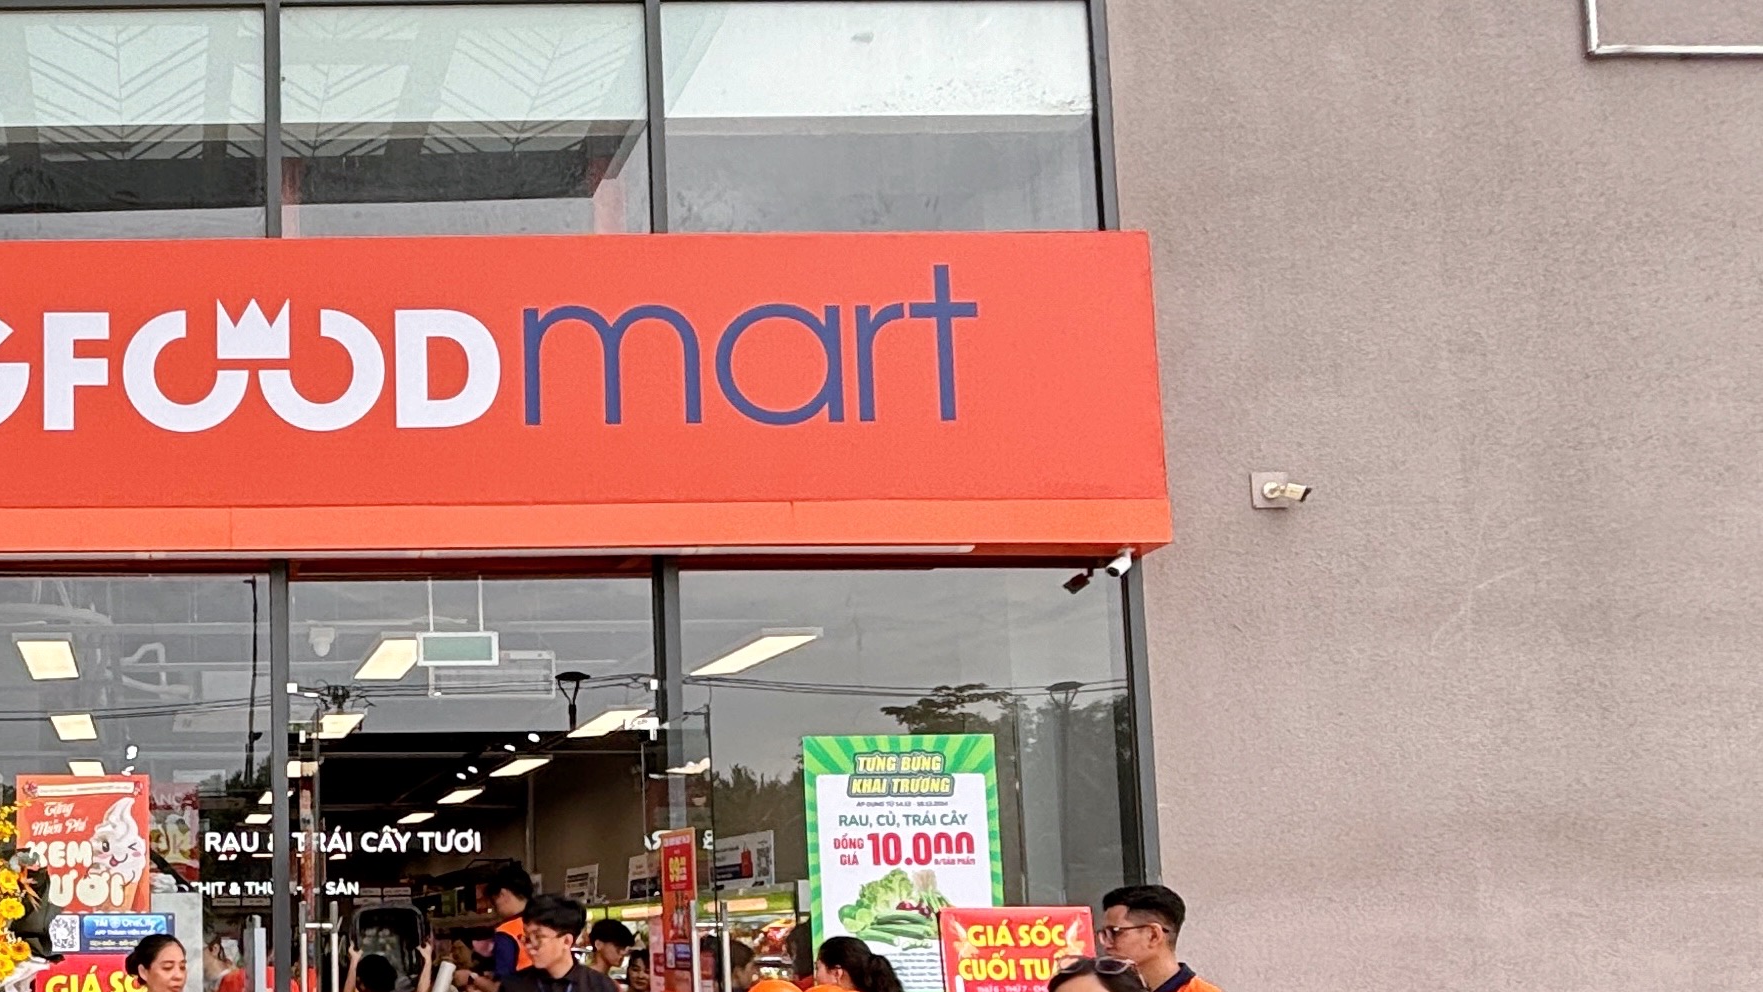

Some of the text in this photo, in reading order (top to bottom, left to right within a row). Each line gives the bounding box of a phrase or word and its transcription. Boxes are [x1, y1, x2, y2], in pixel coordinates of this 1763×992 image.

[851, 778, 887, 794] KHAI
[838, 814, 873, 828] RAU,
[903, 810, 936, 826] TRÁI
[940, 809, 968, 825] CÂY
[205, 832, 259, 852] RAU
[361, 825, 412, 852] CÂY
[417, 829, 481, 852] TƯƠI
[833, 833, 864, 849] ĐỒNG
[840, 852, 859, 866] GIÁ
[49, 869, 126, 907] ƯƠI
[229, 882, 240, 895] &
[325, 878, 359, 895] SẢN
[967, 916, 1066, 947] GIÁ SỐC
[958, 950, 1016, 981] CUỐI
[1019, 948, 1066, 981] TU
